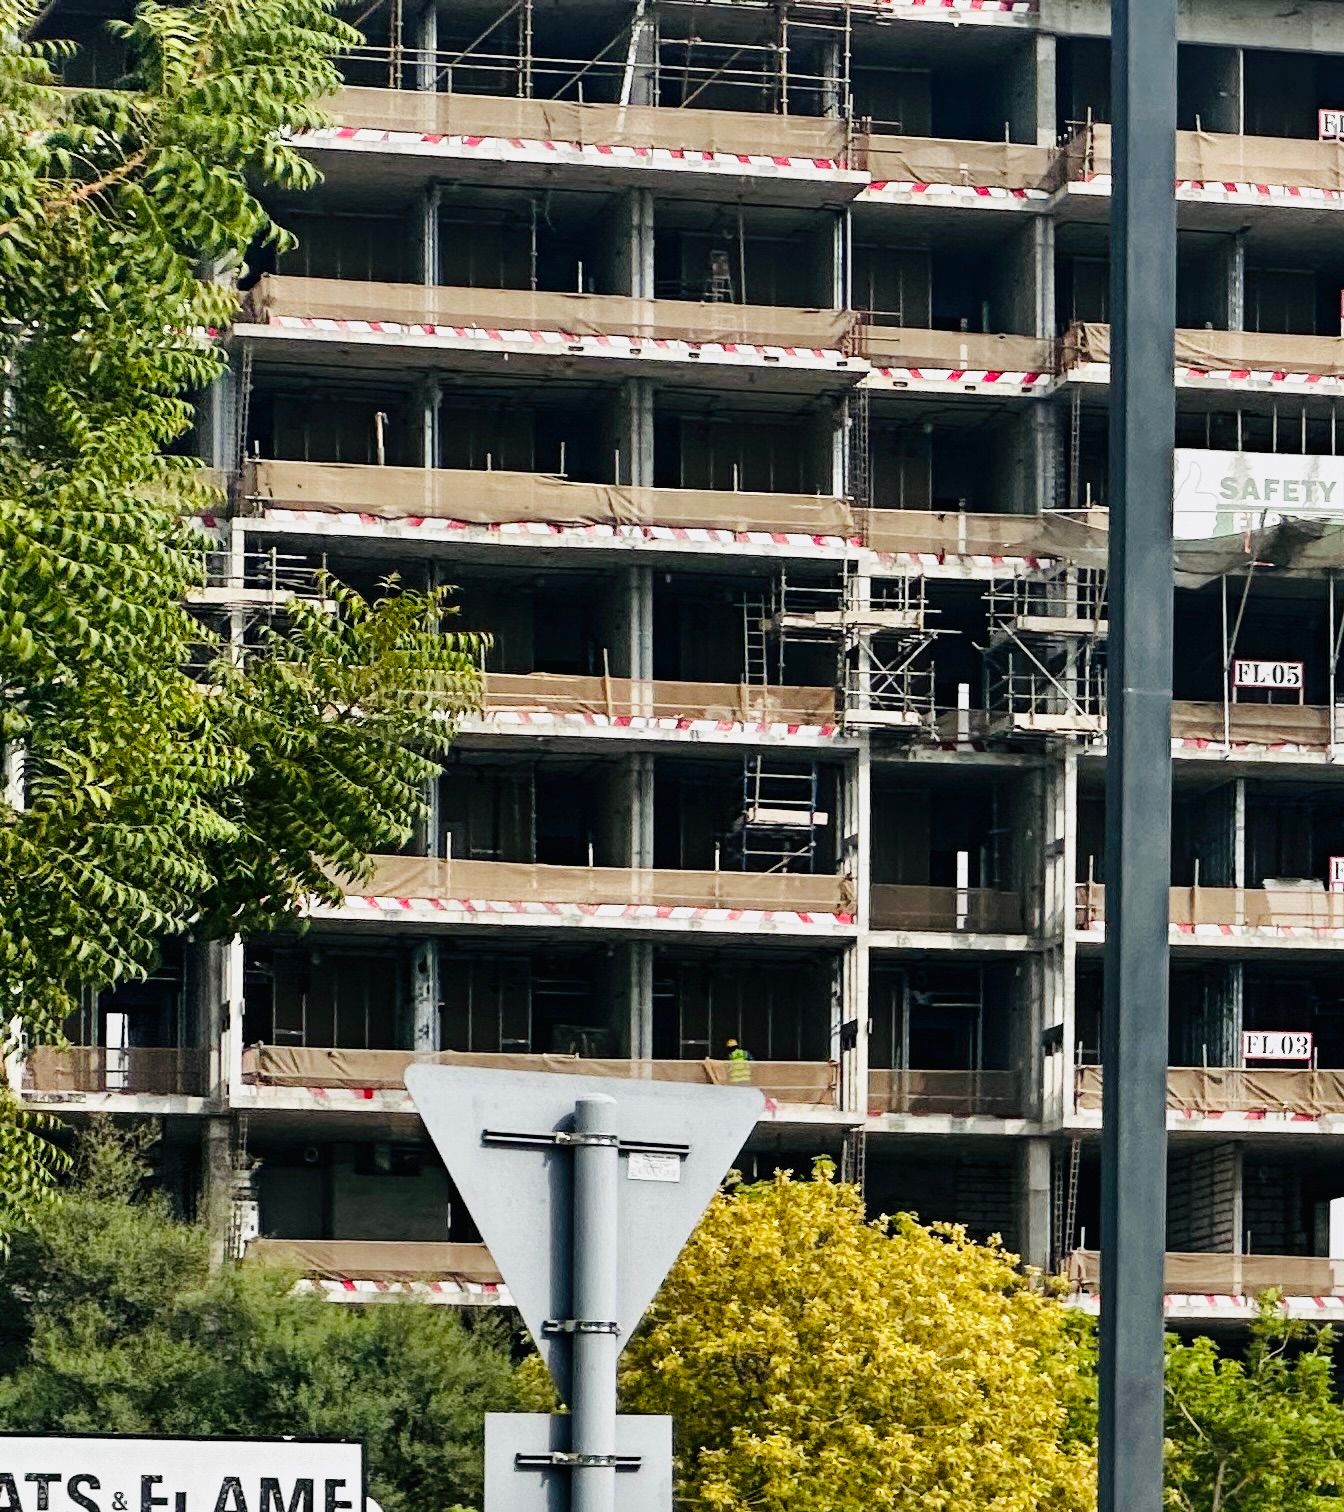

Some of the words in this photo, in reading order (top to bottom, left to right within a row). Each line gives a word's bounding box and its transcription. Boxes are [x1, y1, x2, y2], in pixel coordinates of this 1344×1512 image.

[1218, 476, 1337, 503] SAFETY
[1237, 664, 1266, 683] FL
[1272, 664, 1300, 685] 05
[1247, 1036, 1274, 1054] FL
[1281, 1036, 1308, 1055] 03
[111, 1491, 128, 1512] &
